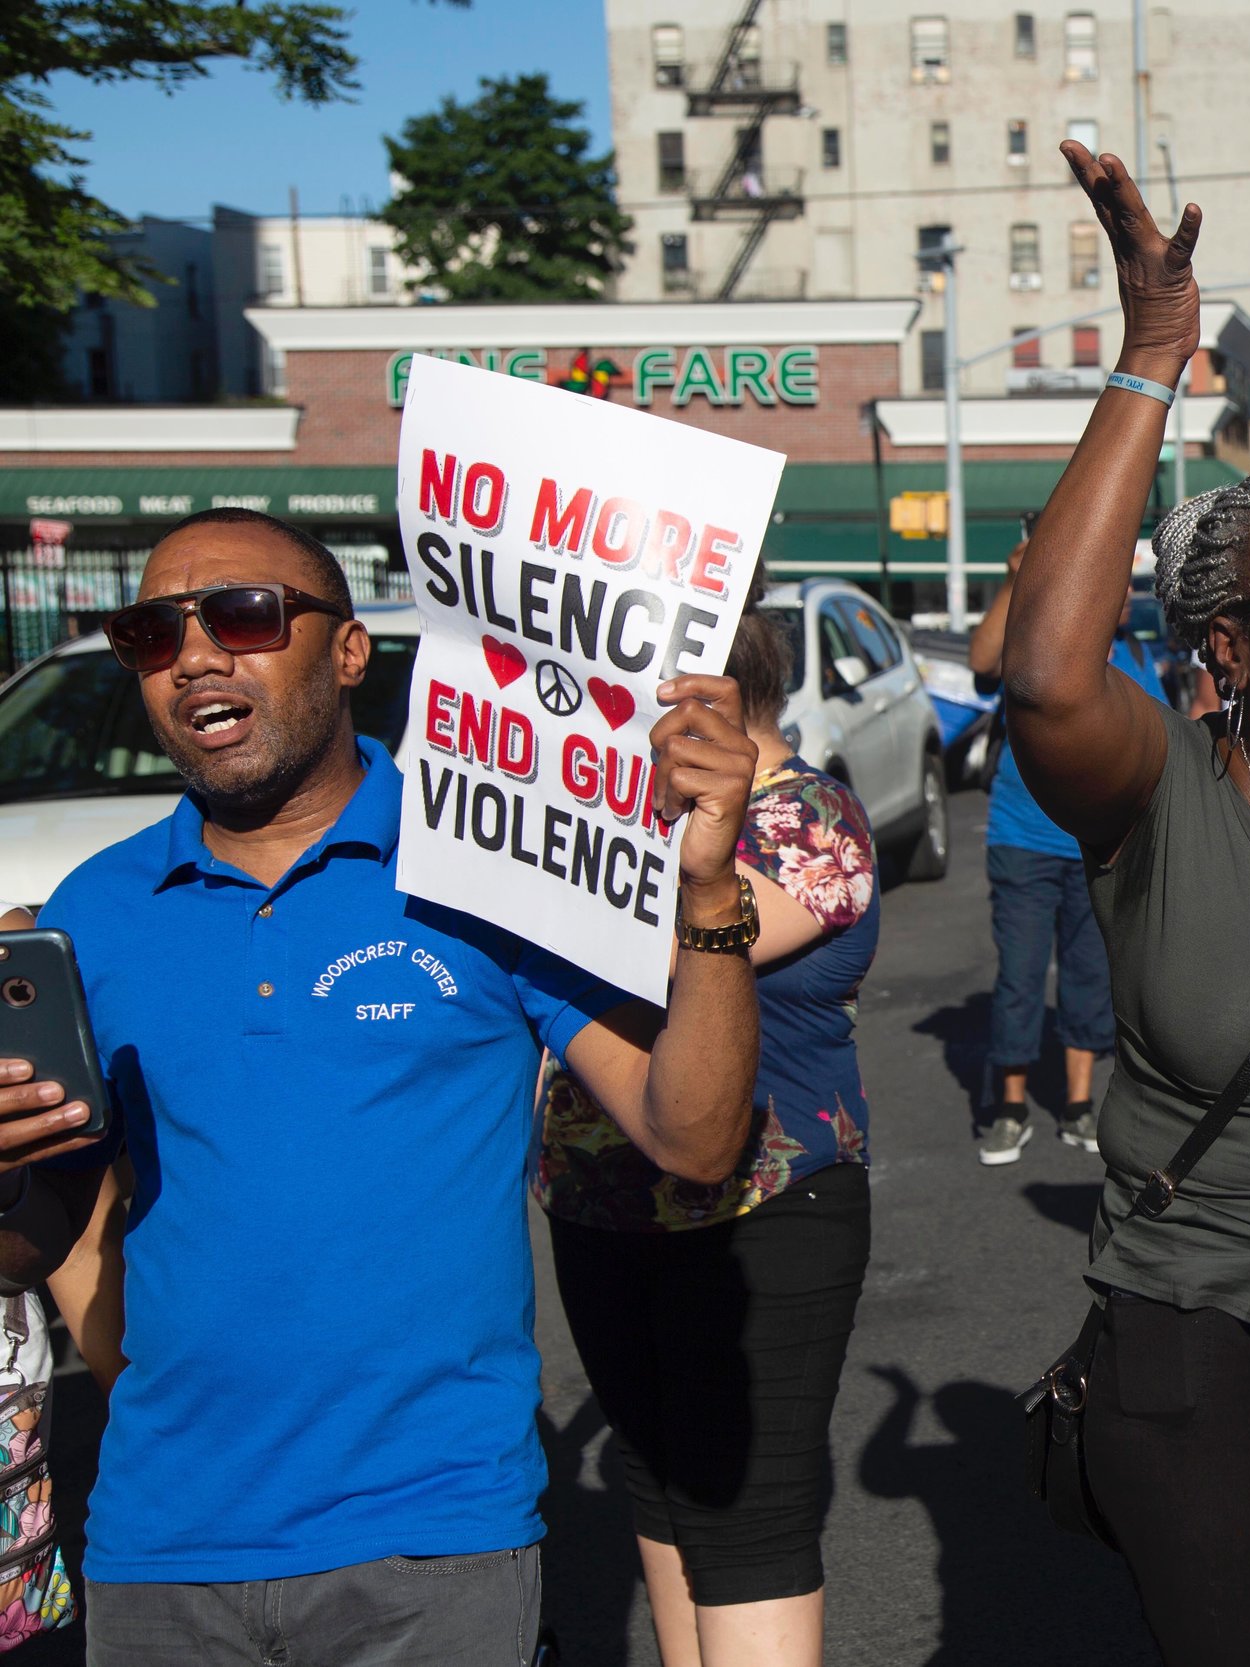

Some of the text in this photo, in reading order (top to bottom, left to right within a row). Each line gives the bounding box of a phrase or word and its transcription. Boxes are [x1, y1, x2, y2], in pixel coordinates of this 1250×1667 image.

[632, 345, 819, 406] FARE
[27, 495, 123, 515] SEAFOOD
[139, 495, 194, 515] MEAT
[288, 495, 379, 514] PRODUCE
[419, 448, 741, 601] NO MORE
[417, 531, 719, 681] SILENCE
[427, 678, 540, 784] END
[420, 758, 665, 927] VIOLENCE
[311, 941, 458, 998] WOODYCREST CENTER
[355, 1003, 416, 1020] STAFF
